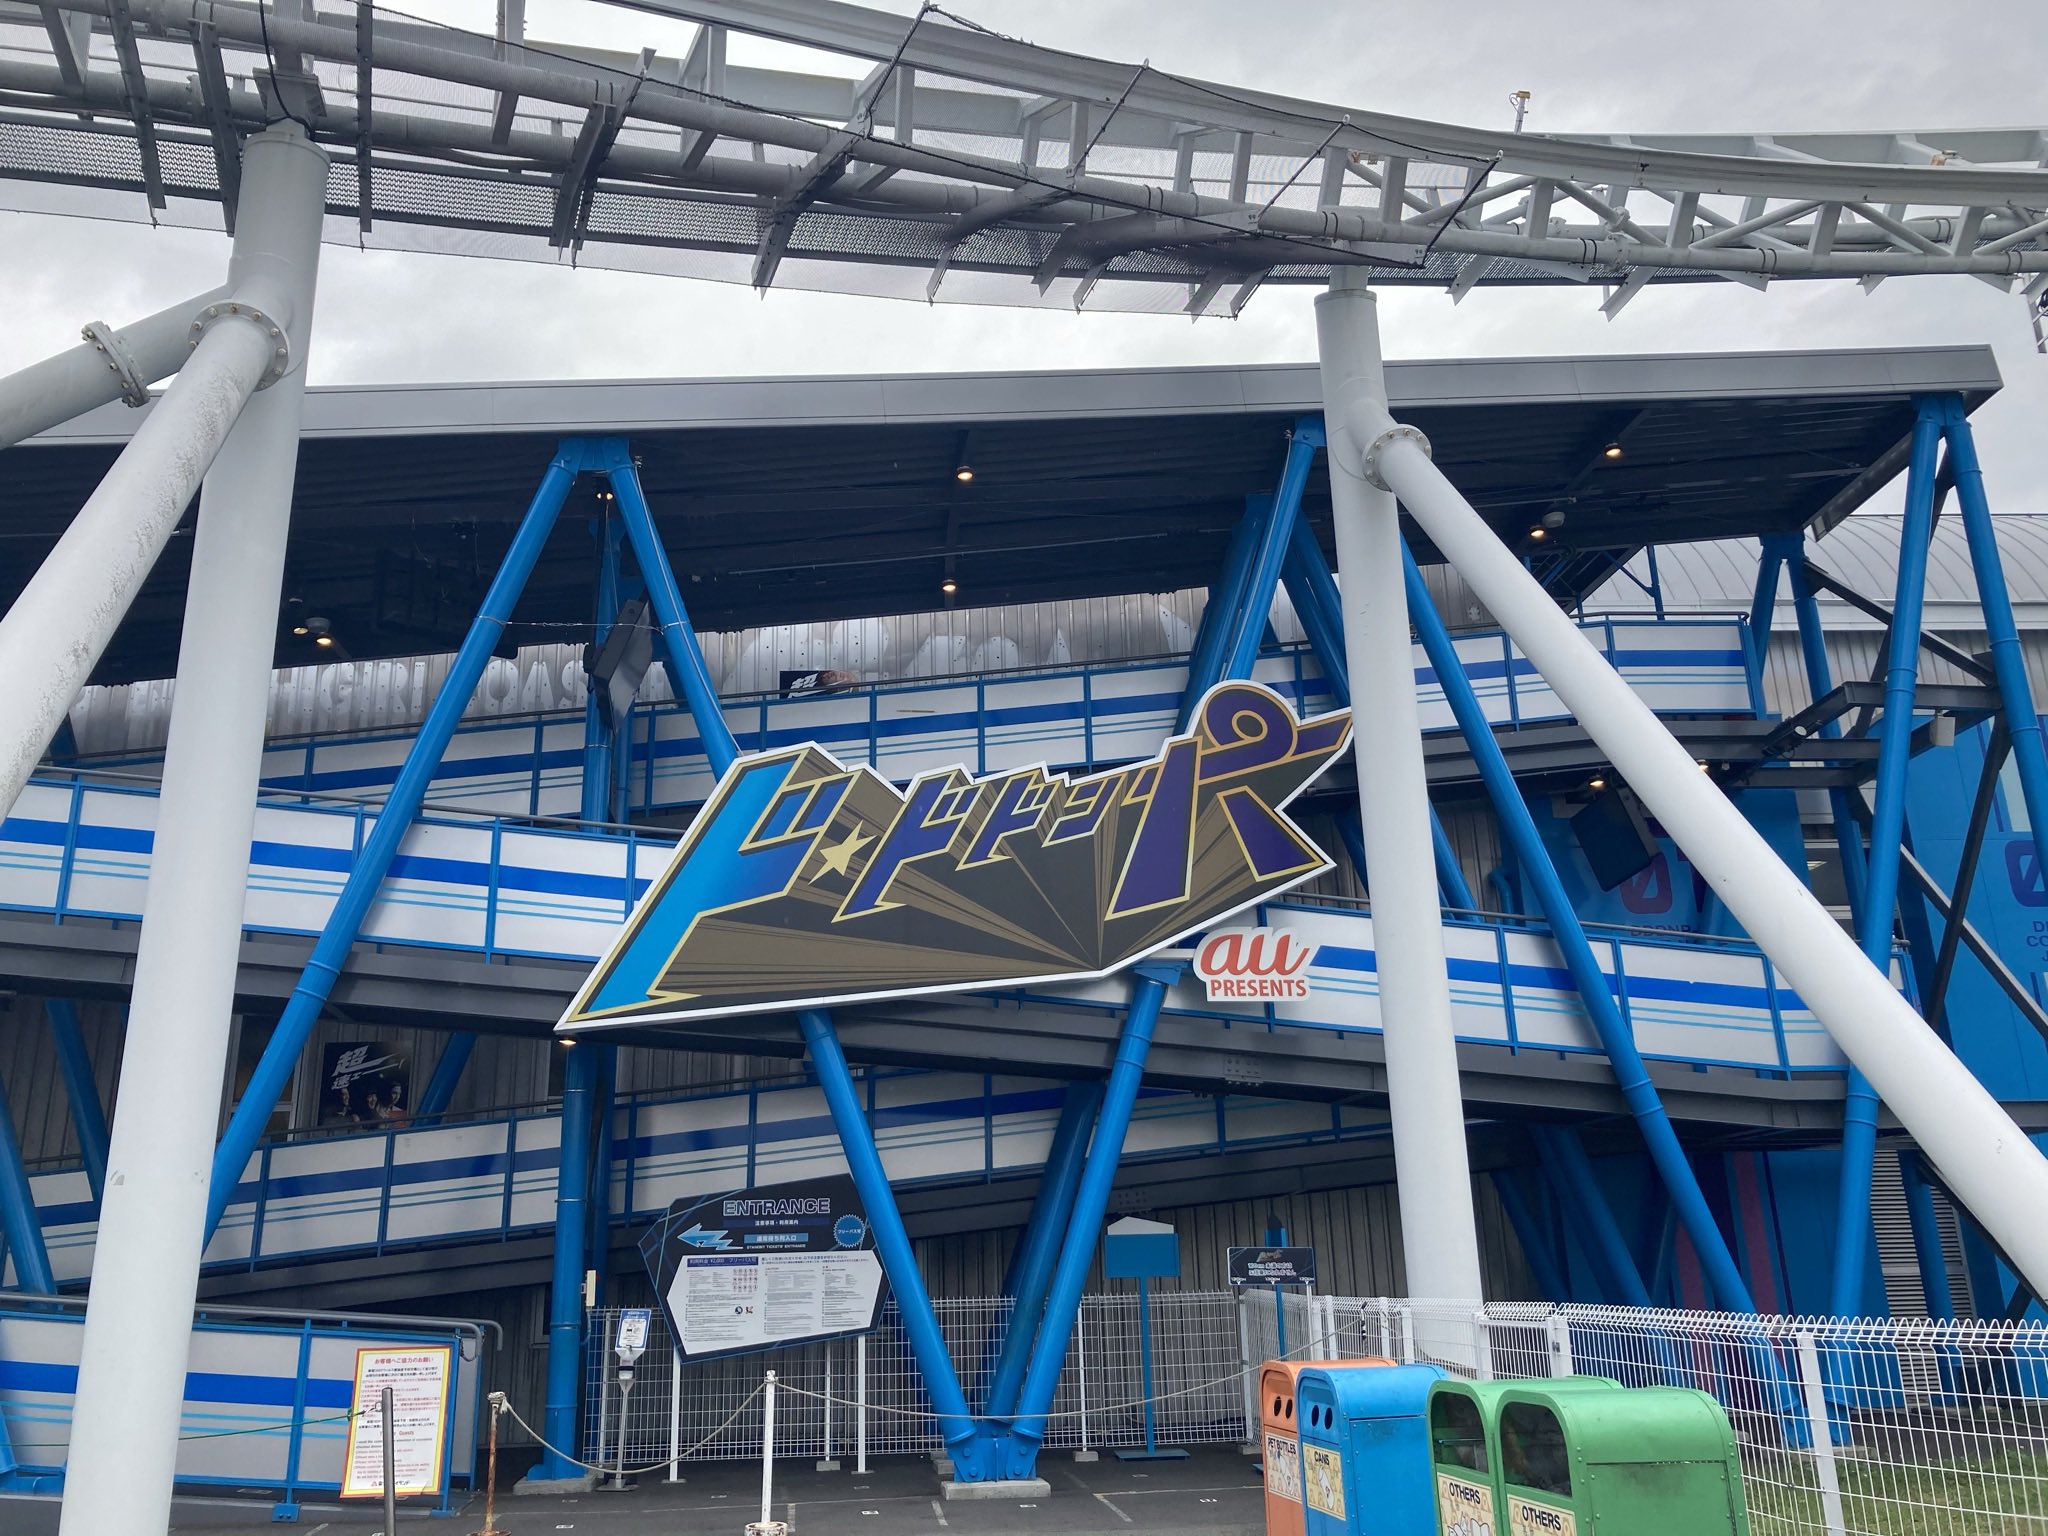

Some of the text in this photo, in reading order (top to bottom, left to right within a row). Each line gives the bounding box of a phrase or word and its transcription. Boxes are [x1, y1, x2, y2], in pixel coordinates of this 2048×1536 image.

[1200, 934, 1310, 976] au
[1210, 979, 1307, 997] PRESENTS
[723, 1198, 831, 1217] ENTRANCE
[1267, 1437, 1297, 1455] PET BOTTLES
[1314, 1451, 1330, 1466] CANS
[1448, 1482, 1481, 1505] OTHERS
[1521, 1505, 1562, 1531] OTHERS
